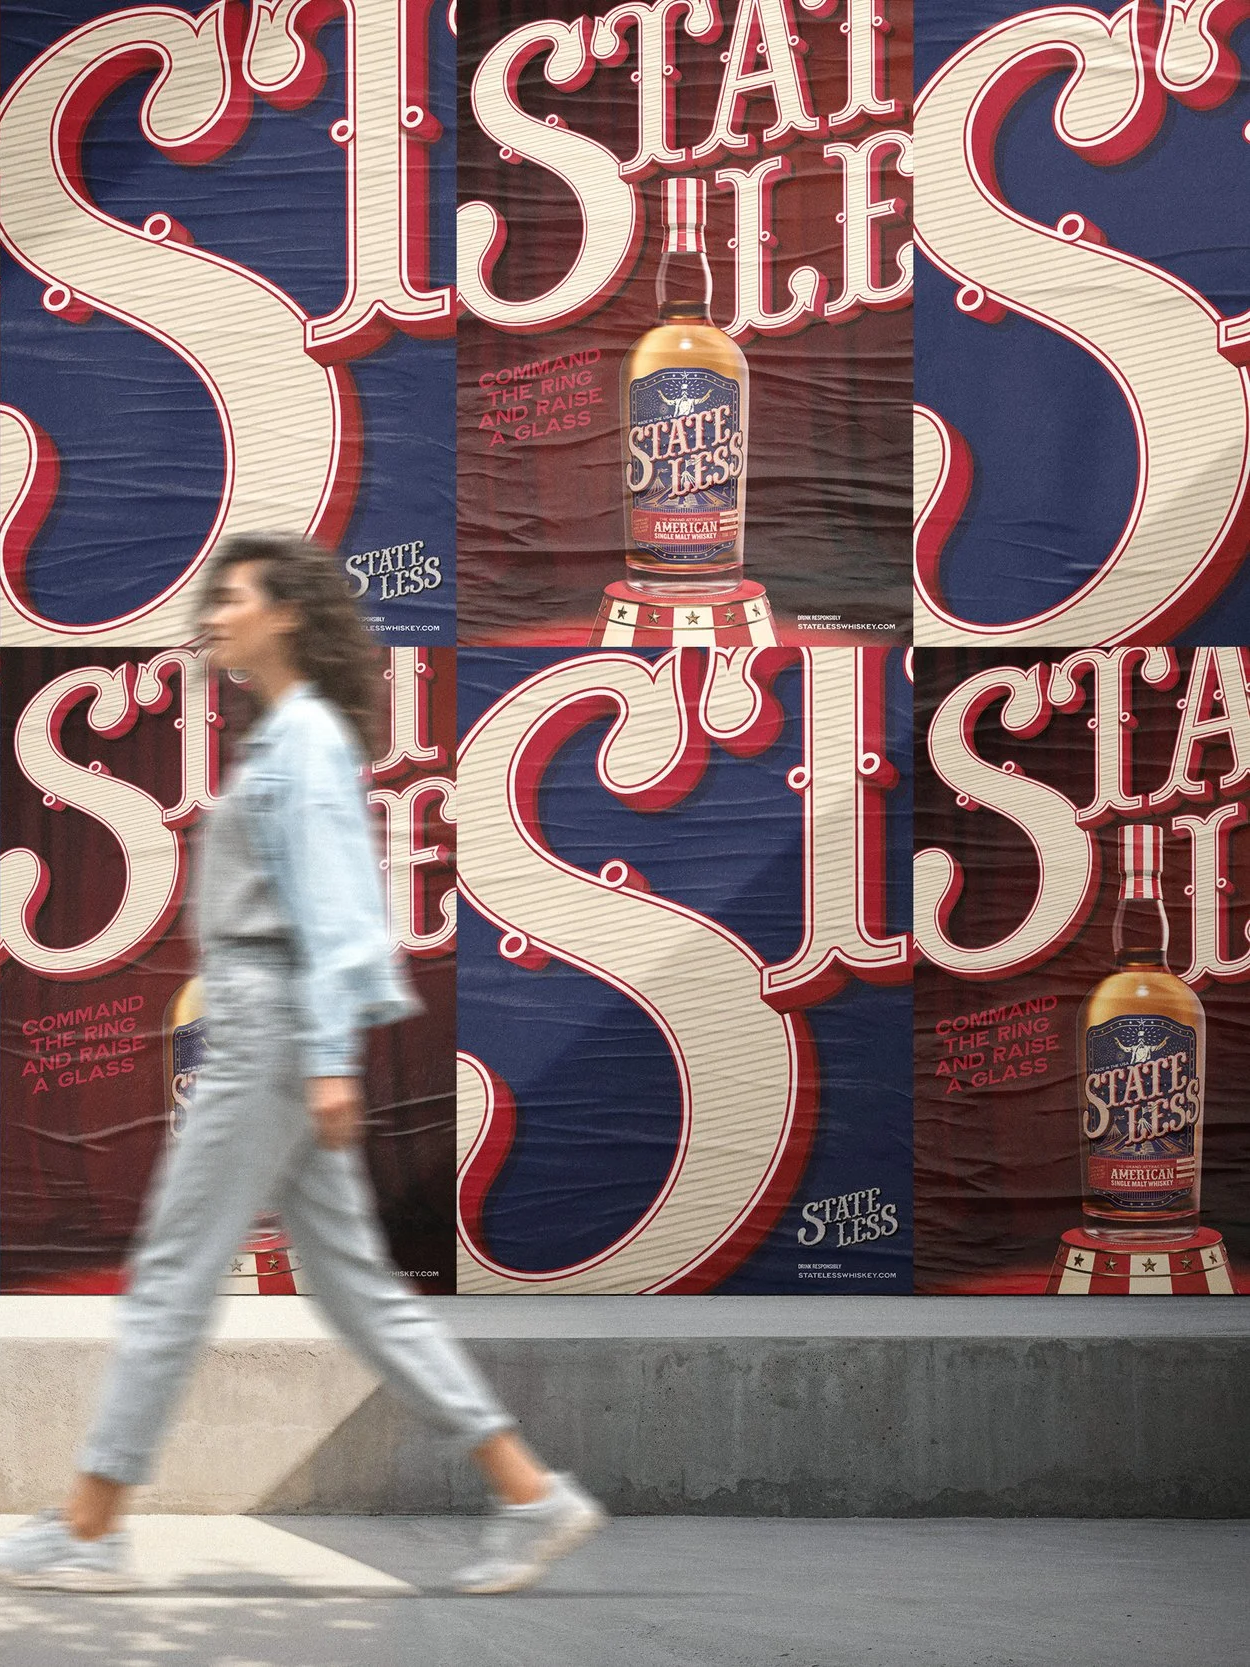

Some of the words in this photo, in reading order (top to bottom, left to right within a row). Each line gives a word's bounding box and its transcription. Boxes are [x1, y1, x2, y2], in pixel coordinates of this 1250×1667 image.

[478, 348, 601, 389] COMMAND
[487, 383, 533, 407] THE
[540, 370, 593, 396] RING
[478, 405, 528, 431] AND
[536, 387, 603, 416] RAISE
[488, 430, 506, 448] A
[514, 410, 592, 440] GLASS
[625, 404, 731, 492] STATE
[667, 430, 743, 499] LESS
[654, 521, 717, 533] AMERICAN
[346, 540, 424, 598] STATE
[380, 556, 442, 600] LESS
[22, 995, 145, 1036] COMMAND
[31, 1030, 77, 1054] THE
[84, 1017, 137, 1043] RING
[935, 995, 1058, 1036] COMMAND
[944, 1030, 990, 1054] THE
[997, 1017, 1050, 1043] RING
[22, 1052, 72, 1078] AND
[80, 1034, 147, 1064] RAISE
[32, 1077, 50, 1095] A
[58, 1057, 136, 1087] GLASS
[935, 1052, 985, 1078] AND
[993, 1034, 1060, 1064] RAISE
[945, 1077, 963, 1095] A
[971, 1057, 1048, 1087] GLASS
[1082, 1051, 1188, 1139] STATE
[1124, 1077, 1200, 1146] LESS
[1111, 1168, 1174, 1180] AMERICAN
[797, 1187, 881, 1246] STATE
[836, 1203, 898, 1248] LESS
